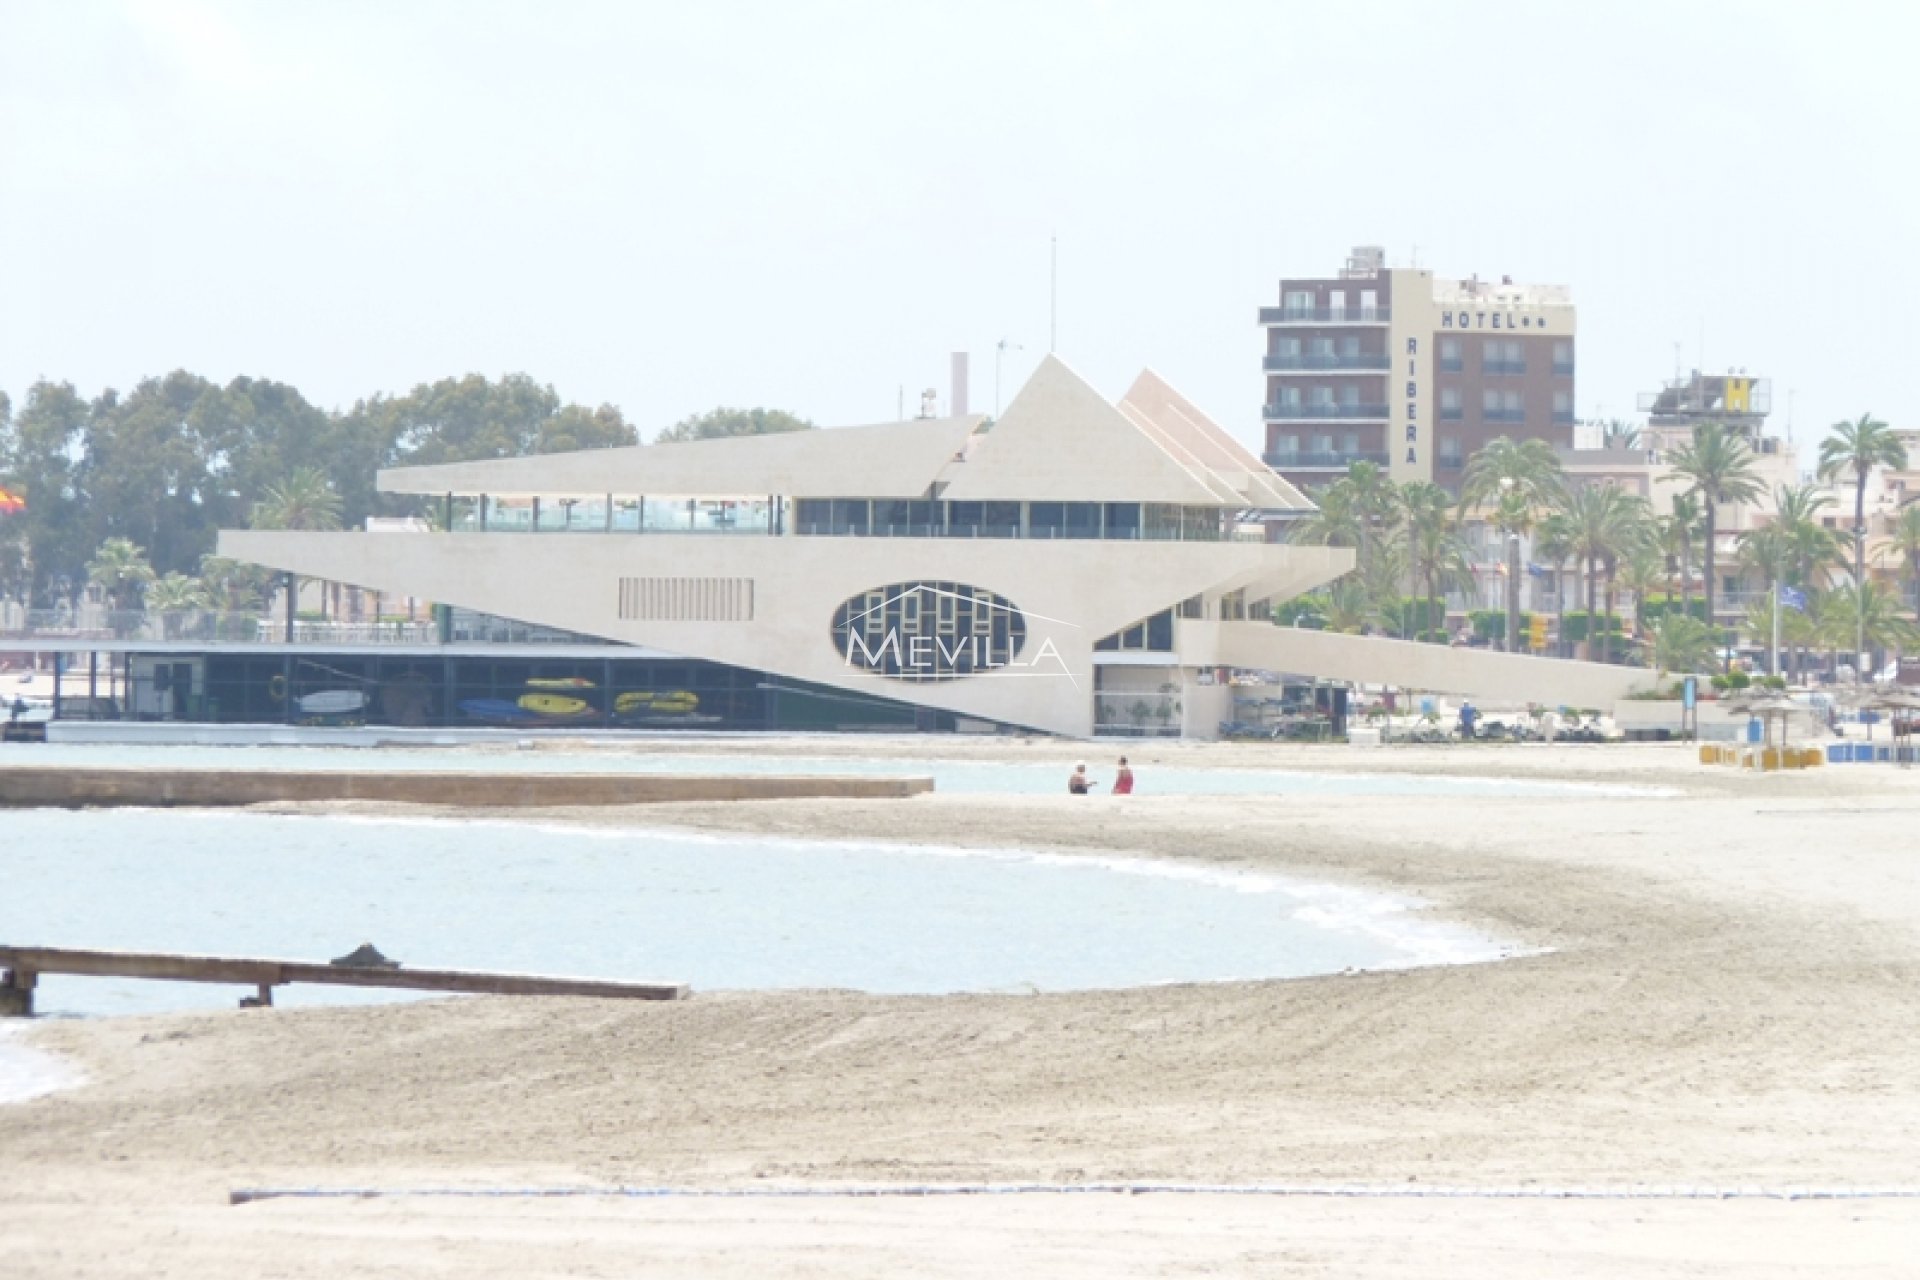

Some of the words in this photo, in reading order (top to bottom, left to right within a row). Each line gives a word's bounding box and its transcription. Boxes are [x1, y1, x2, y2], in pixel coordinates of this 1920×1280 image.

[1442, 311, 1516, 329] HOTEL
[1407, 337, 1417, 463] RIBERA
[1727, 377, 1750, 412] H
